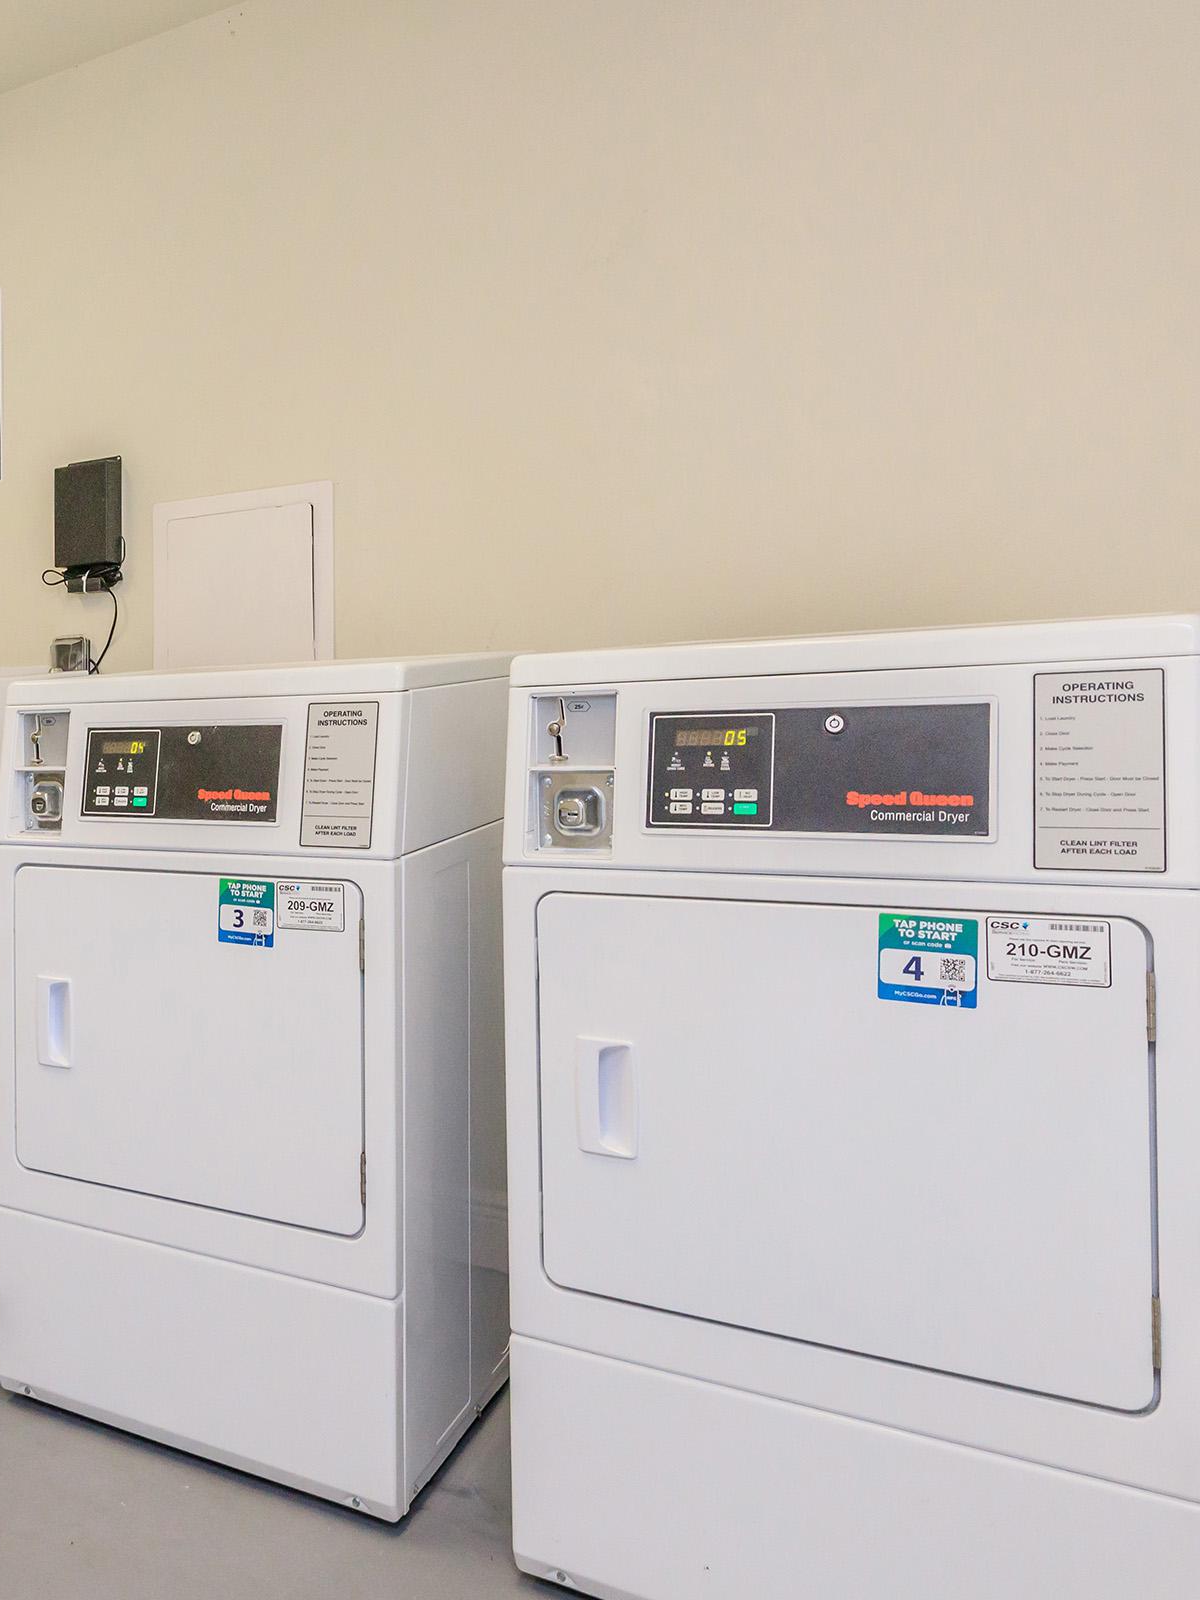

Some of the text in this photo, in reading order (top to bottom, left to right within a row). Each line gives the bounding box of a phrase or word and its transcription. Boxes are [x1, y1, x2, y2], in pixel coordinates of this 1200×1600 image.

[1062, 680, 1134, 692] OPERATING
[1052, 692, 1145, 704] INSTRUCTIONS
[724, 729, 747, 746] 05
[197, 788, 270, 803] Speed Queen
[846, 791, 974, 808] Speed Queen
[210, 802, 267, 815] Commercial Dryer
[870, 810, 970, 824] Commercial Dryer
[227, 882, 267, 892] TAP PHONE
[287, 900, 334, 913] 209-GMZ
[232, 909, 244, 928] 3
[990, 920, 1020, 930] CSC
[893, 919, 963, 933] TAP PHONE
[898, 928, 958, 941] TO START
[1006, 942, 1092, 960] 210-GMZ
[902, 956, 924, 981] 4
[894, 990, 937, 999] MyCSCGo.com
